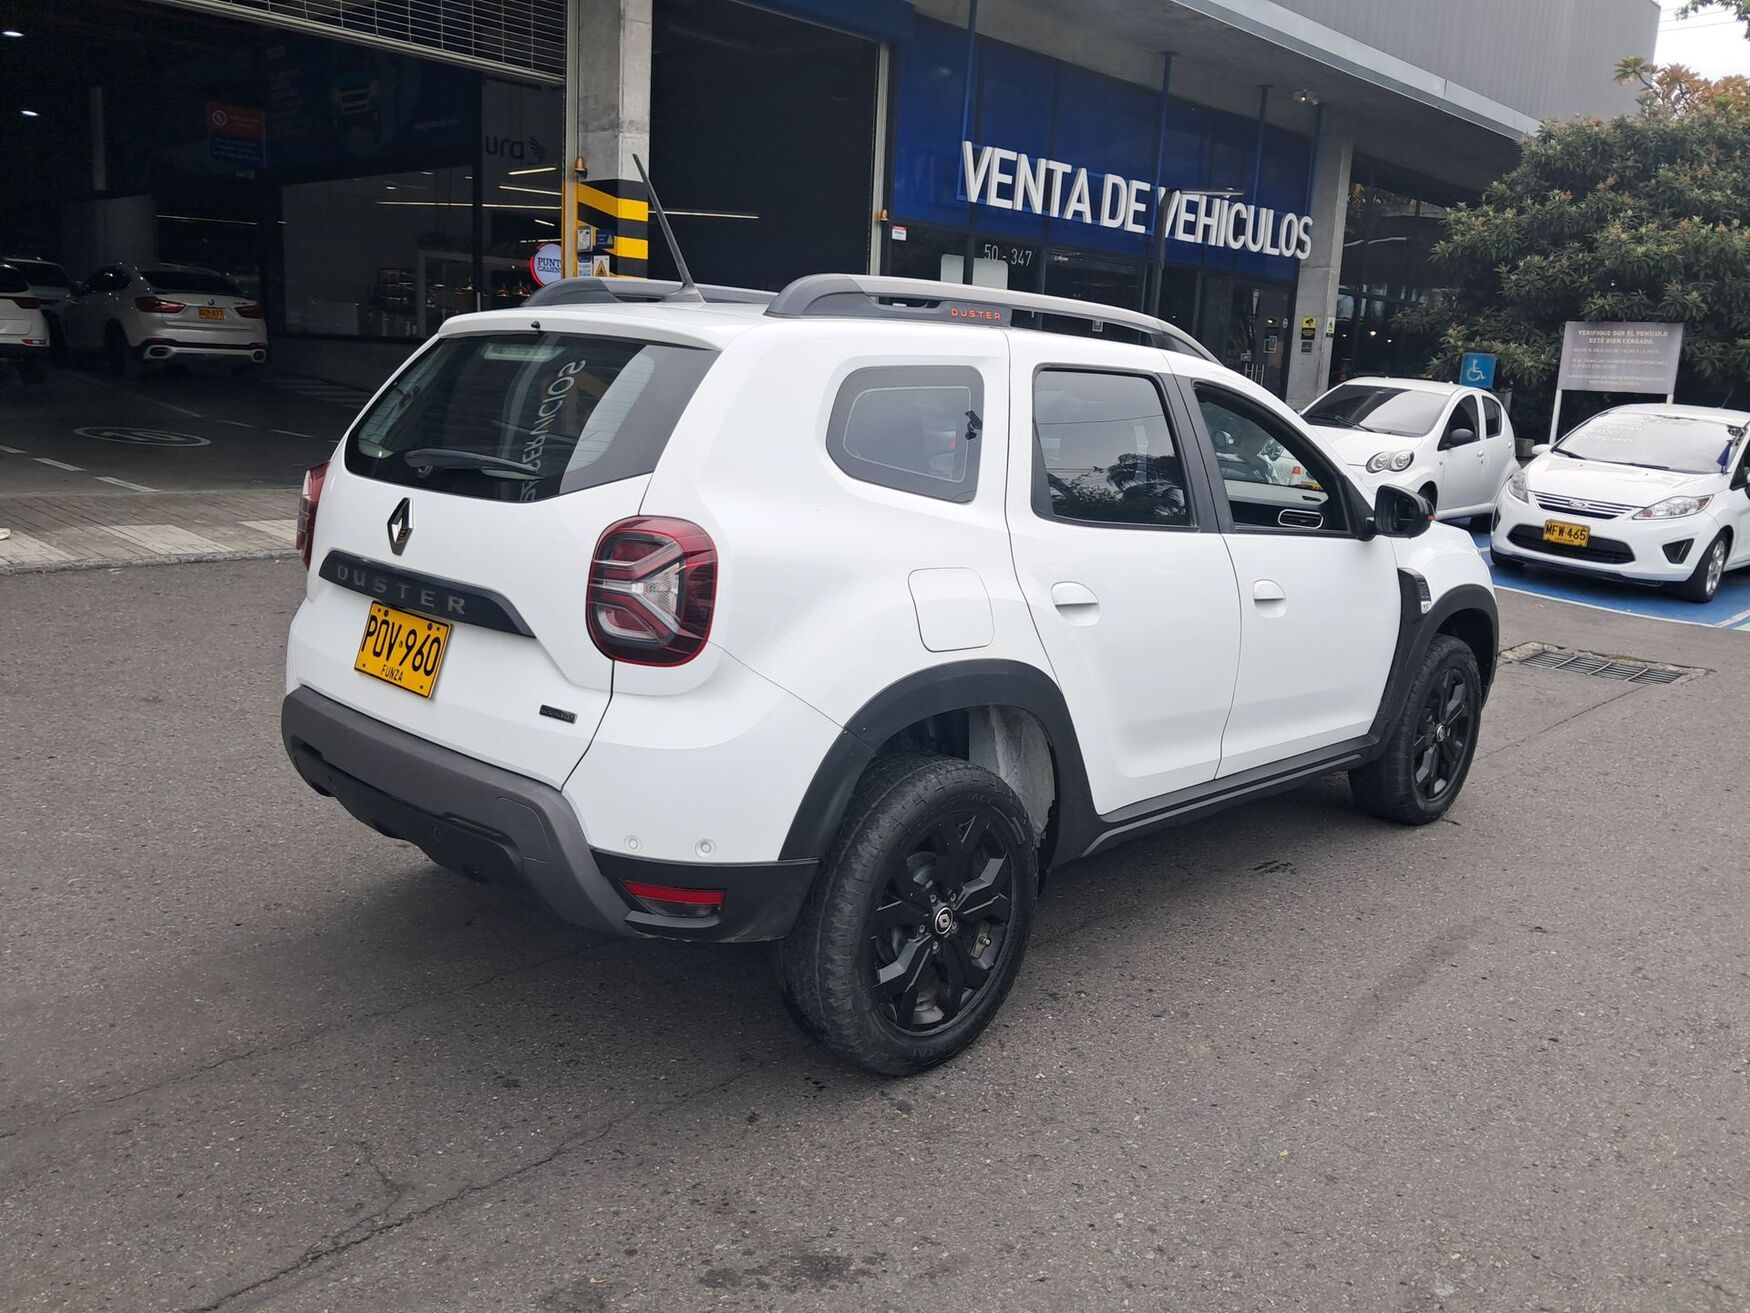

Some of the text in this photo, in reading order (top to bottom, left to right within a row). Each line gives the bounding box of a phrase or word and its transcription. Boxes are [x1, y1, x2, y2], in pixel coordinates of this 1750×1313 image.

[486, 136, 524, 160] ura
[962, 141, 1092, 224] VENTA
[1099, 173, 1151, 235] DE
[537, 257, 562, 267] PUNT
[984, 243, 999, 262] 50
[1010, 248, 1033, 268] 347
[951, 308, 1001, 320] DUSTER
[336, 564, 467, 615] DUSTER
[380, 664, 405, 683] FUNZA
